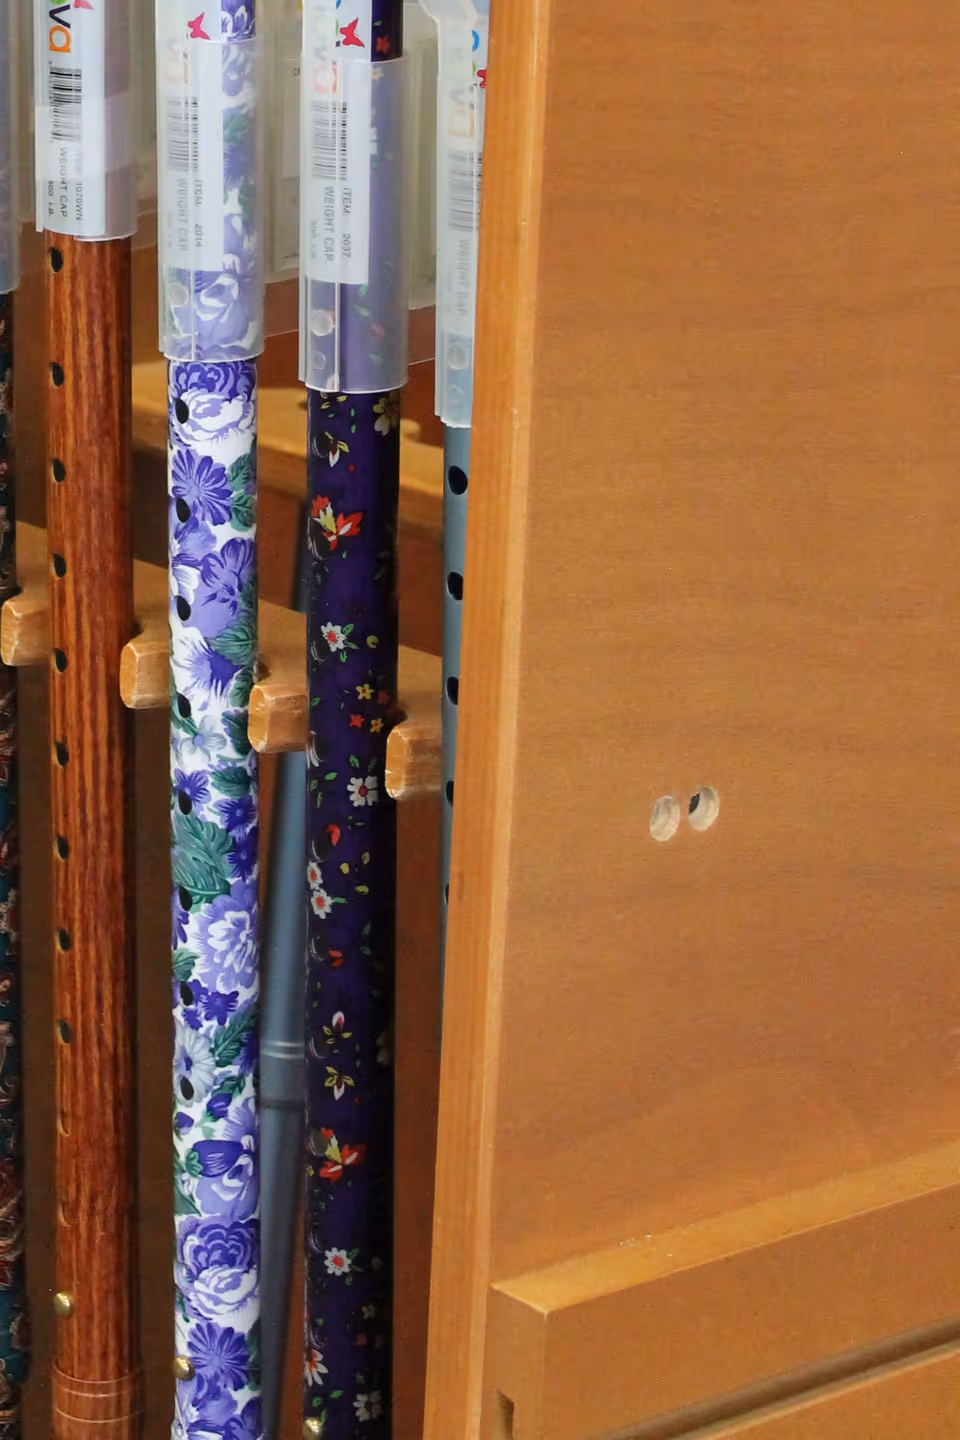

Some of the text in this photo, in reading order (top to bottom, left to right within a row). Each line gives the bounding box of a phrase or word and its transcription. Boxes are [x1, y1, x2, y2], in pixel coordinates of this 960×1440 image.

[58, 147, 69, 220] WEIGHT CAP.
[75, 182, 84, 222] 1070WN
[176, 178, 190, 225] WEIGHT
[323, 186, 336, 234] WEIGHT
[194, 223, 204, 248] 2014
